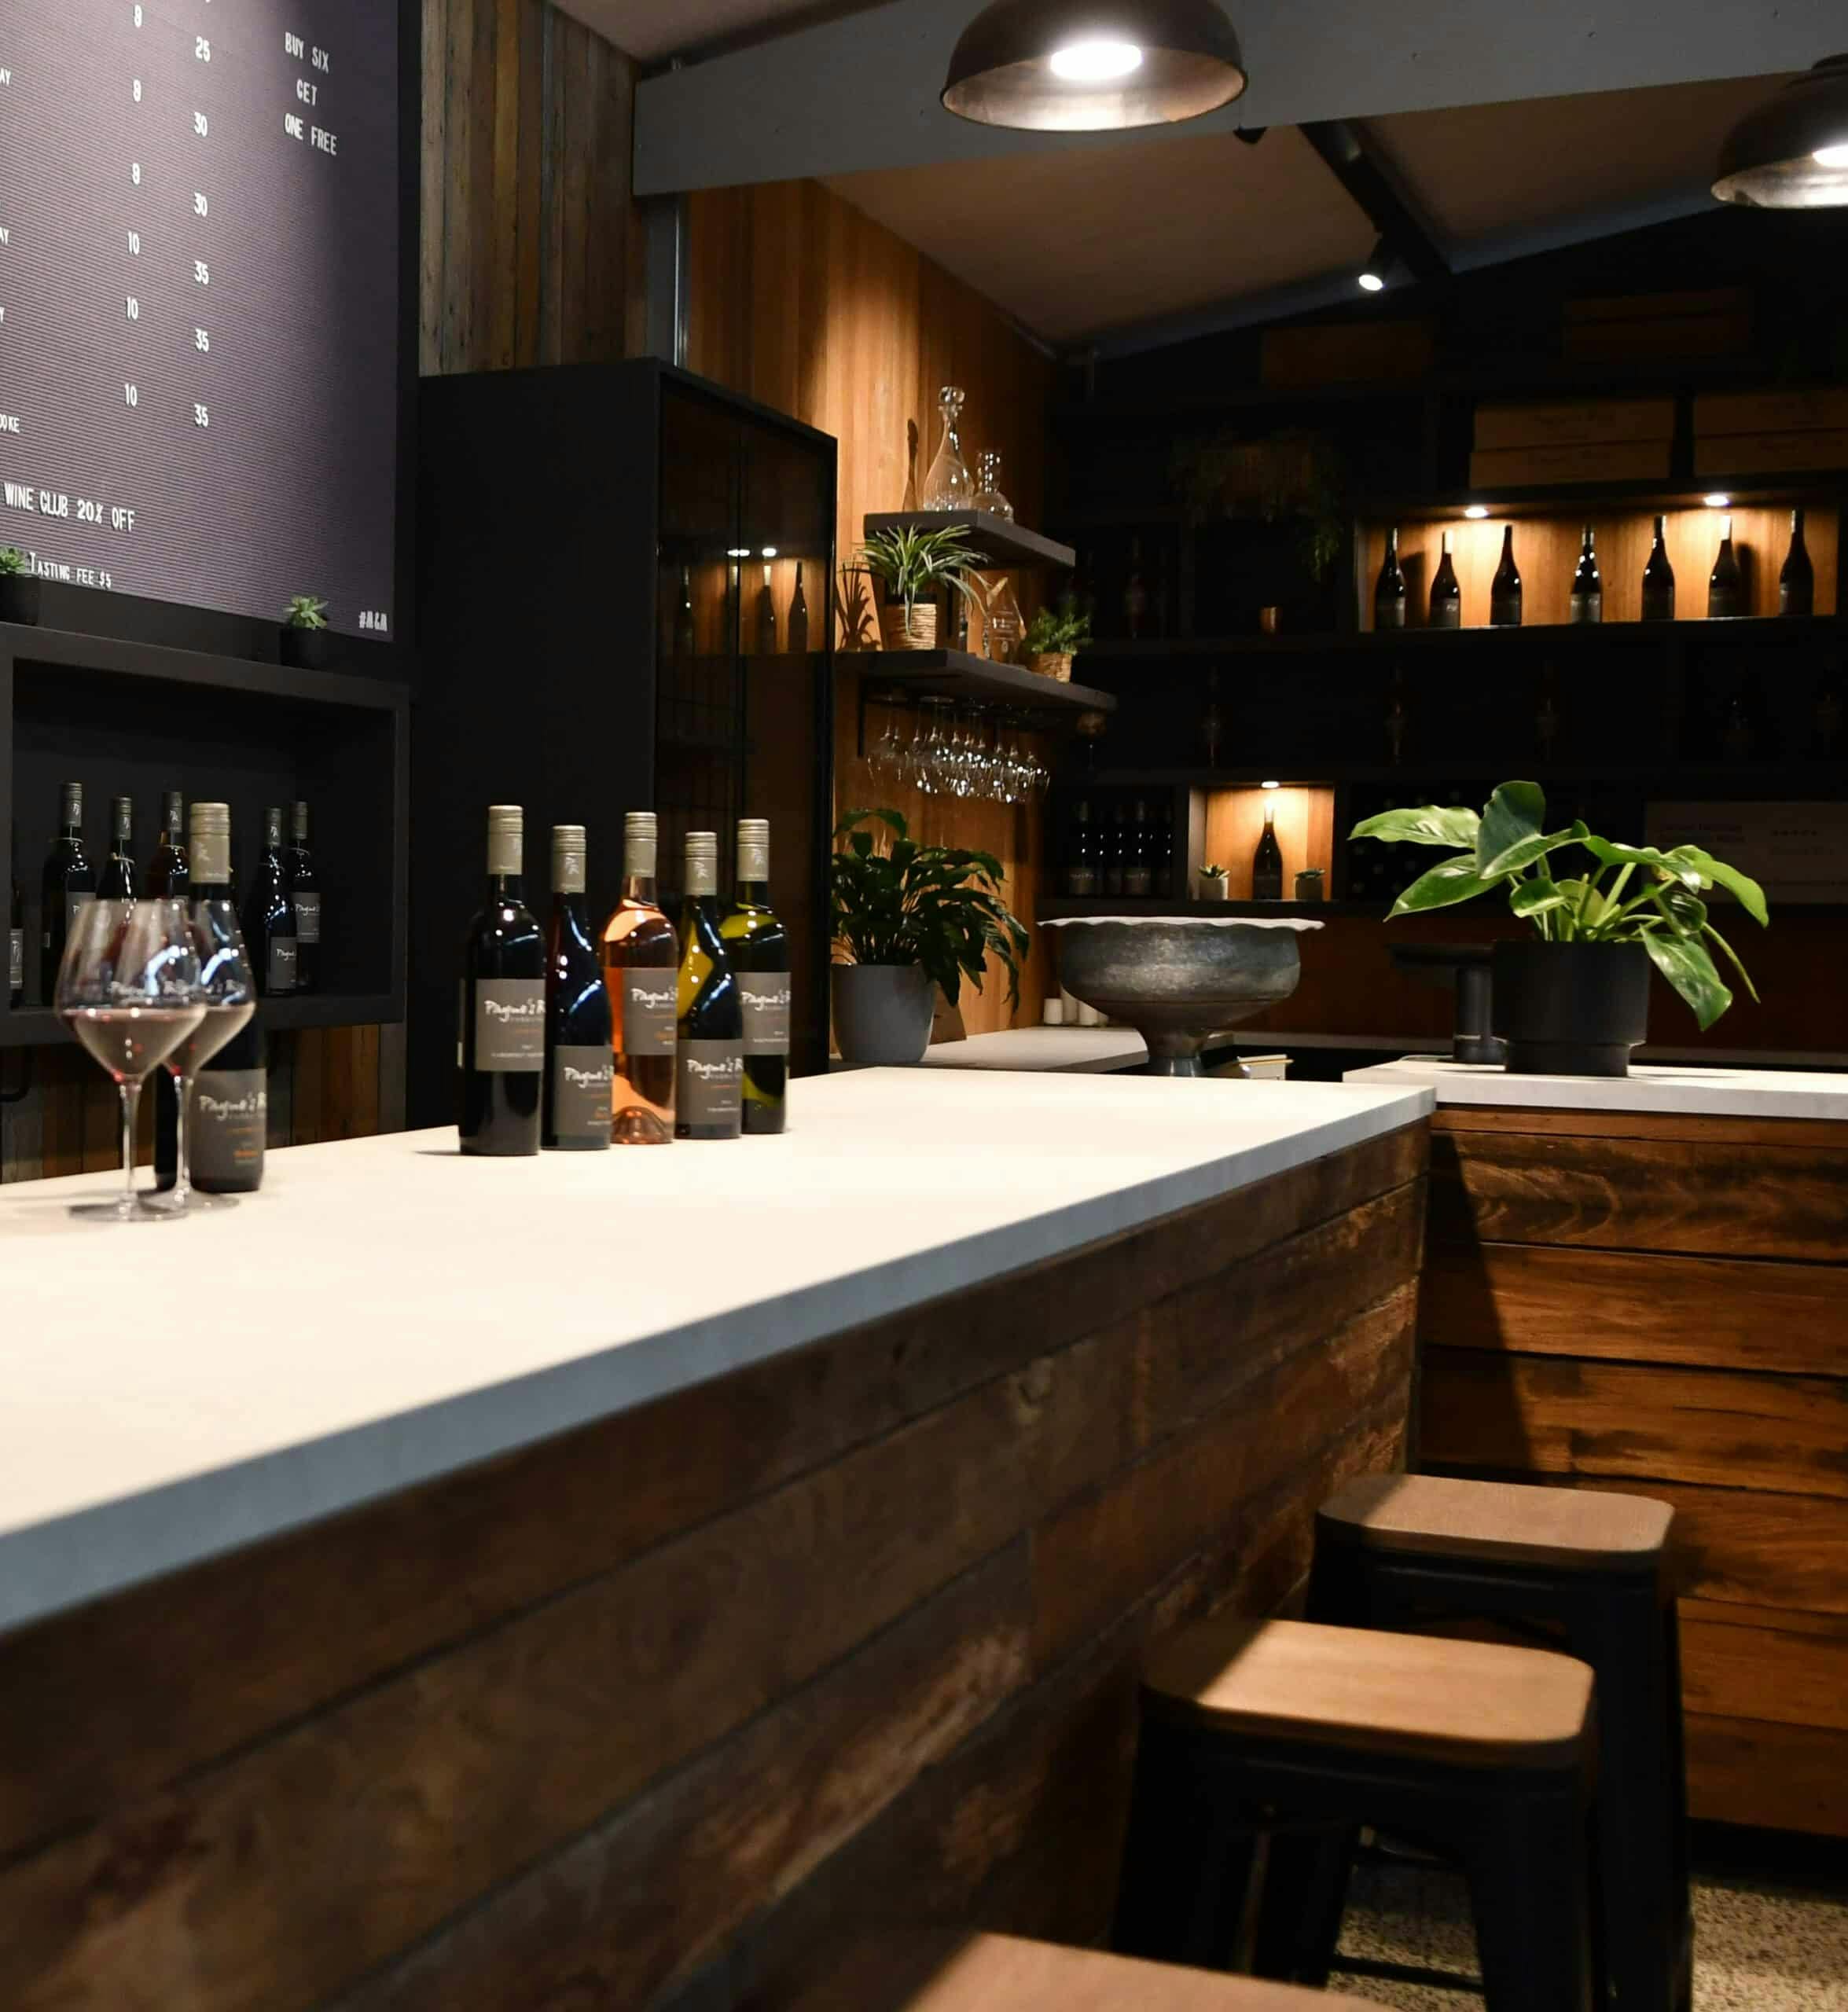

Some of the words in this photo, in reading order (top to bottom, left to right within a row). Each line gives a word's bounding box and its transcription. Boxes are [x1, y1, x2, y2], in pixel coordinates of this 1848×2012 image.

[134, 5, 142, 27] 8
[196, 36, 211, 62] 25
[285, 32, 304, 59] BUY
[312, 46, 330, 73] SIX
[133, 80, 141, 102] 8
[296, 79, 318, 106] GET
[194, 112, 208, 137] 30
[285, 113, 303, 140] ONE
[310, 126, 337, 156] FREE
[193, 193, 208, 217] 30
[127, 231, 140, 255] 10
[194, 260, 209, 285] 35
[126, 296, 139, 319] 10
[195, 328, 210, 352] 35
[124, 383, 138, 406] 10
[193, 403, 209, 427] 35
[4, 483, 34, 510] WINE
[39, 490, 69, 518] CLUB
[76, 499, 104, 524] 20%
[112, 507, 136, 532] OFF
[77, 567, 94, 586] FEE
[99, 571, 112, 588] $5
